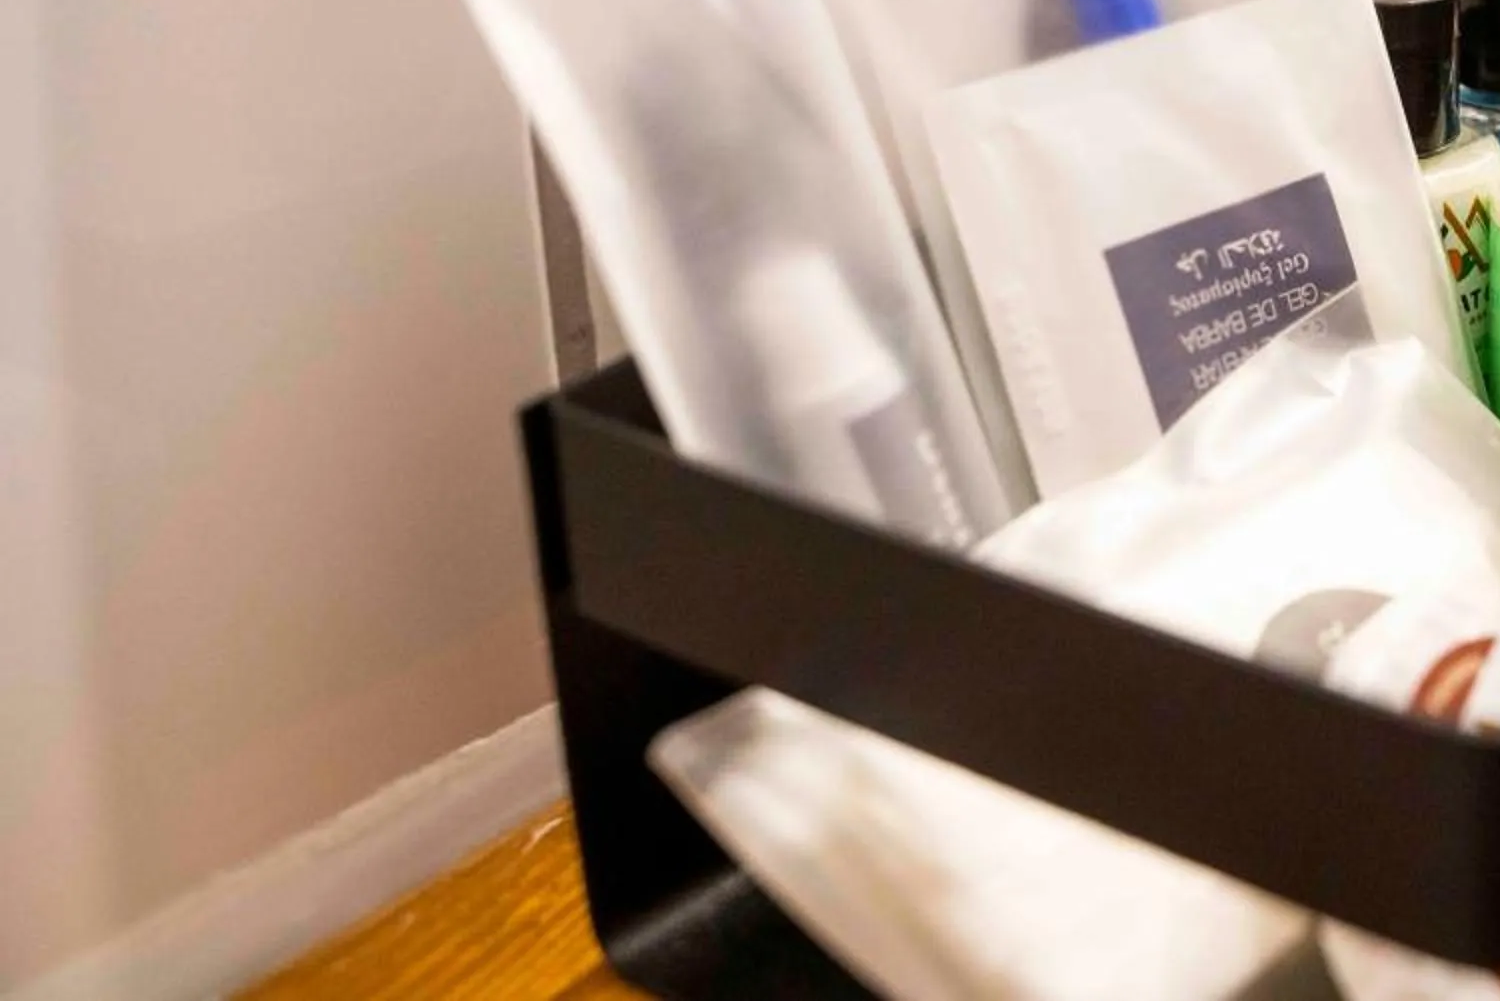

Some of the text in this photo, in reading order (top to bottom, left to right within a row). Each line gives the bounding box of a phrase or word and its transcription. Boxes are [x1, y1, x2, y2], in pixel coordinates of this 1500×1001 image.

[1277, 252, 1309, 280] Gel
[1279, 282, 1319, 312] GEL
[1247, 298, 1278, 328] DE
[1178, 309, 1247, 354] BARBA
